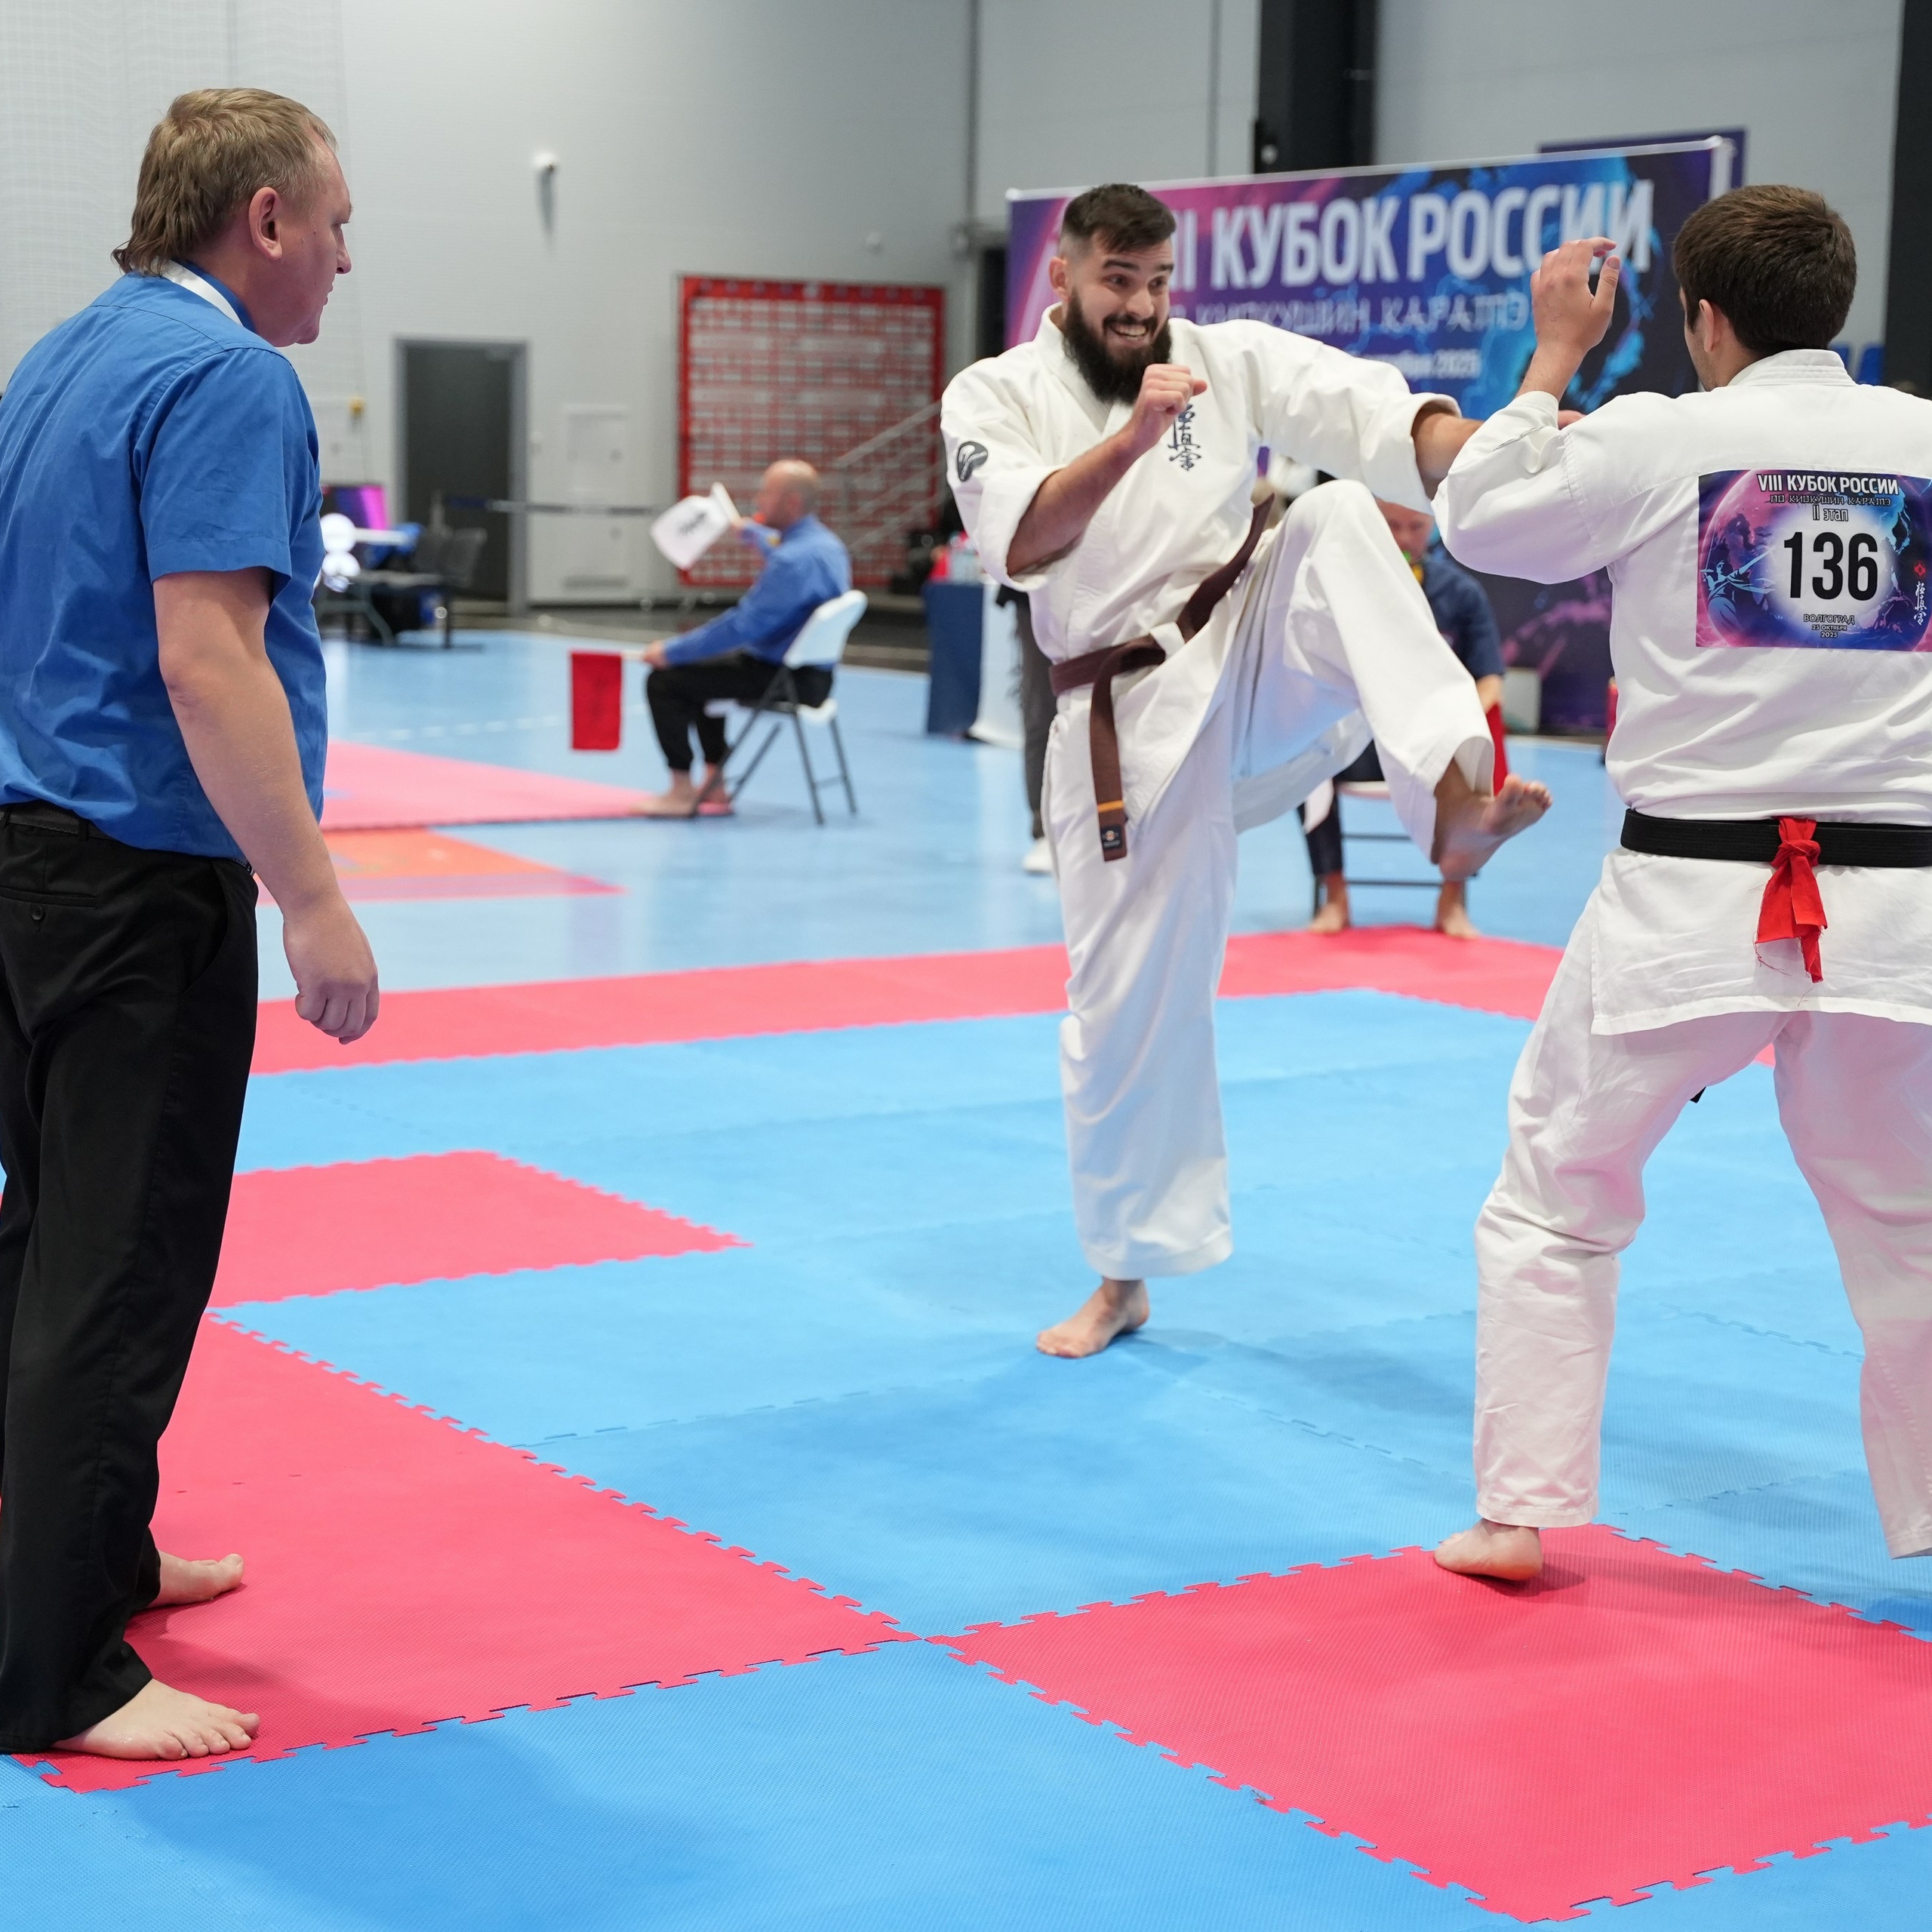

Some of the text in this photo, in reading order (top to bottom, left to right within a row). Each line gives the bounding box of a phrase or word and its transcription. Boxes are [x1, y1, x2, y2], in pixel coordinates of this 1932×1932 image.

[1210, 195, 1401, 291] КУБОК
[1406, 179, 1656, 283] РОССИИ
[1757, 474, 1900, 495] VIII КУБОК РОССИИ
[1769, 494, 1786, 503] ПО
[1789, 494, 1845, 505] КИОКУШИН
[1812, 504, 1849, 521] II этап
[1783, 531, 1878, 601] 136
[1803, 614, 1856, 626] ВОЛГОГРАД
